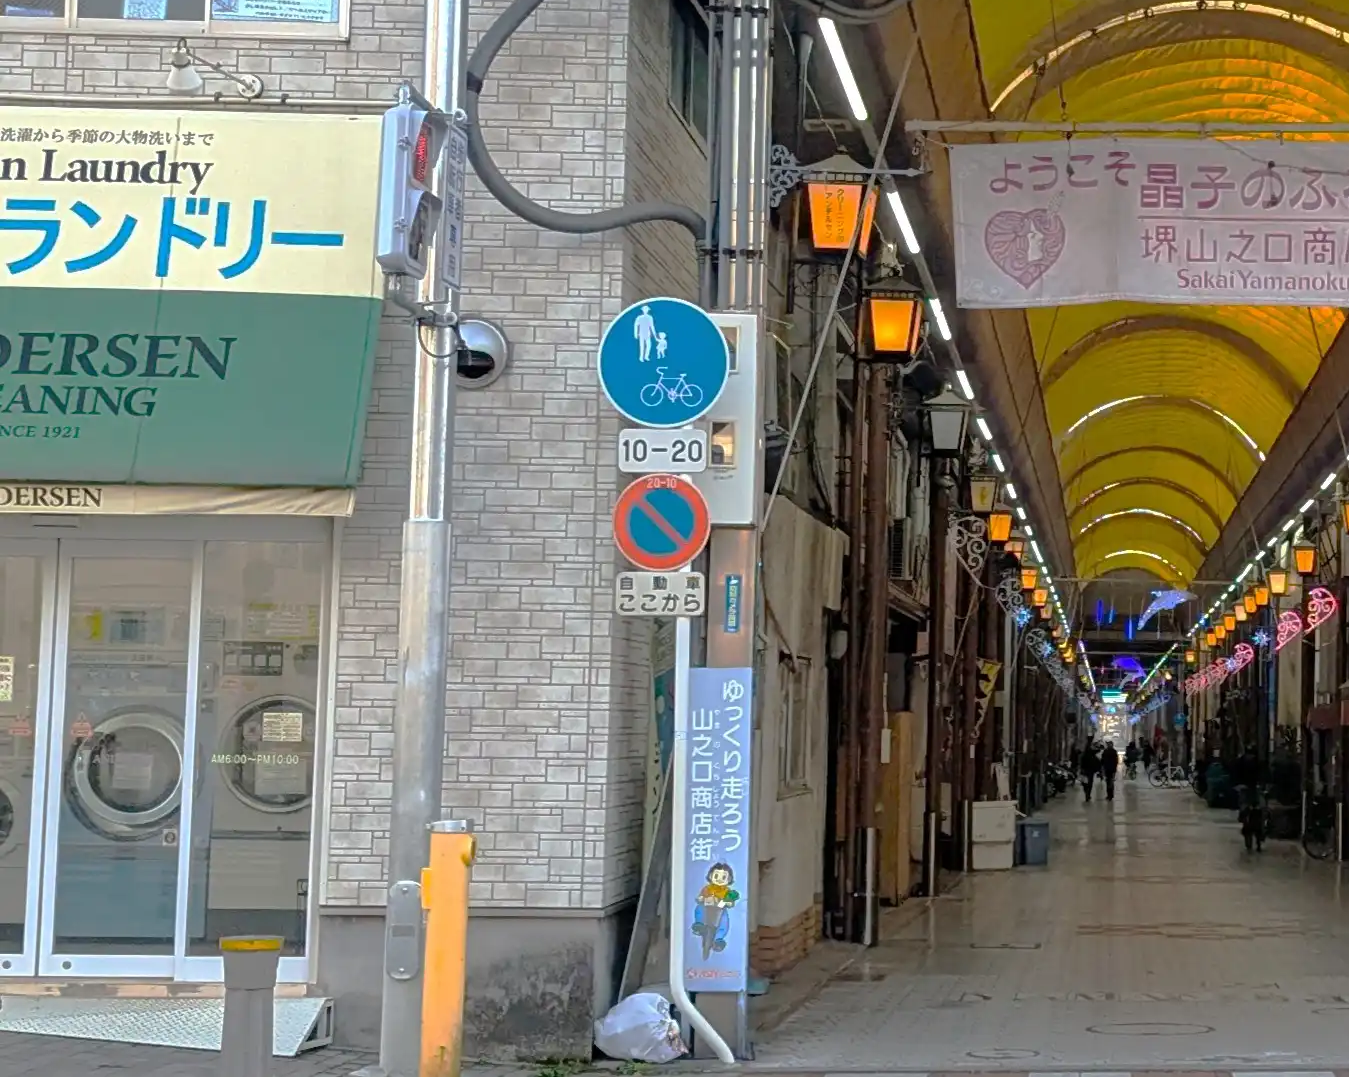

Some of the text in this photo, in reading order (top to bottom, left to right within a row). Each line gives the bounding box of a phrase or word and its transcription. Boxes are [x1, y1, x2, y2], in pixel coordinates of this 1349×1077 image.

[0, 127, 215, 146] 洗濯から季節の大物洗いまで
[38, 148, 215, 195] Laundry
[989, 151, 1136, 194] ようこそ
[0, 196, 345, 279] ランドリー
[0, 332, 238, 381] ERSEN
[0, 383, 158, 417] ANING
[42, 425, 81, 439] 1921
[622, 439, 703, 463] 10-20
[646, 476, 678, 489] 20-10
[619, 576, 701, 591] 自動車
[618, 593, 702, 614] ここから
[720, 679, 745, 853] ゆっくり走ろう
[689, 707, 714, 862] 山之口商店街
